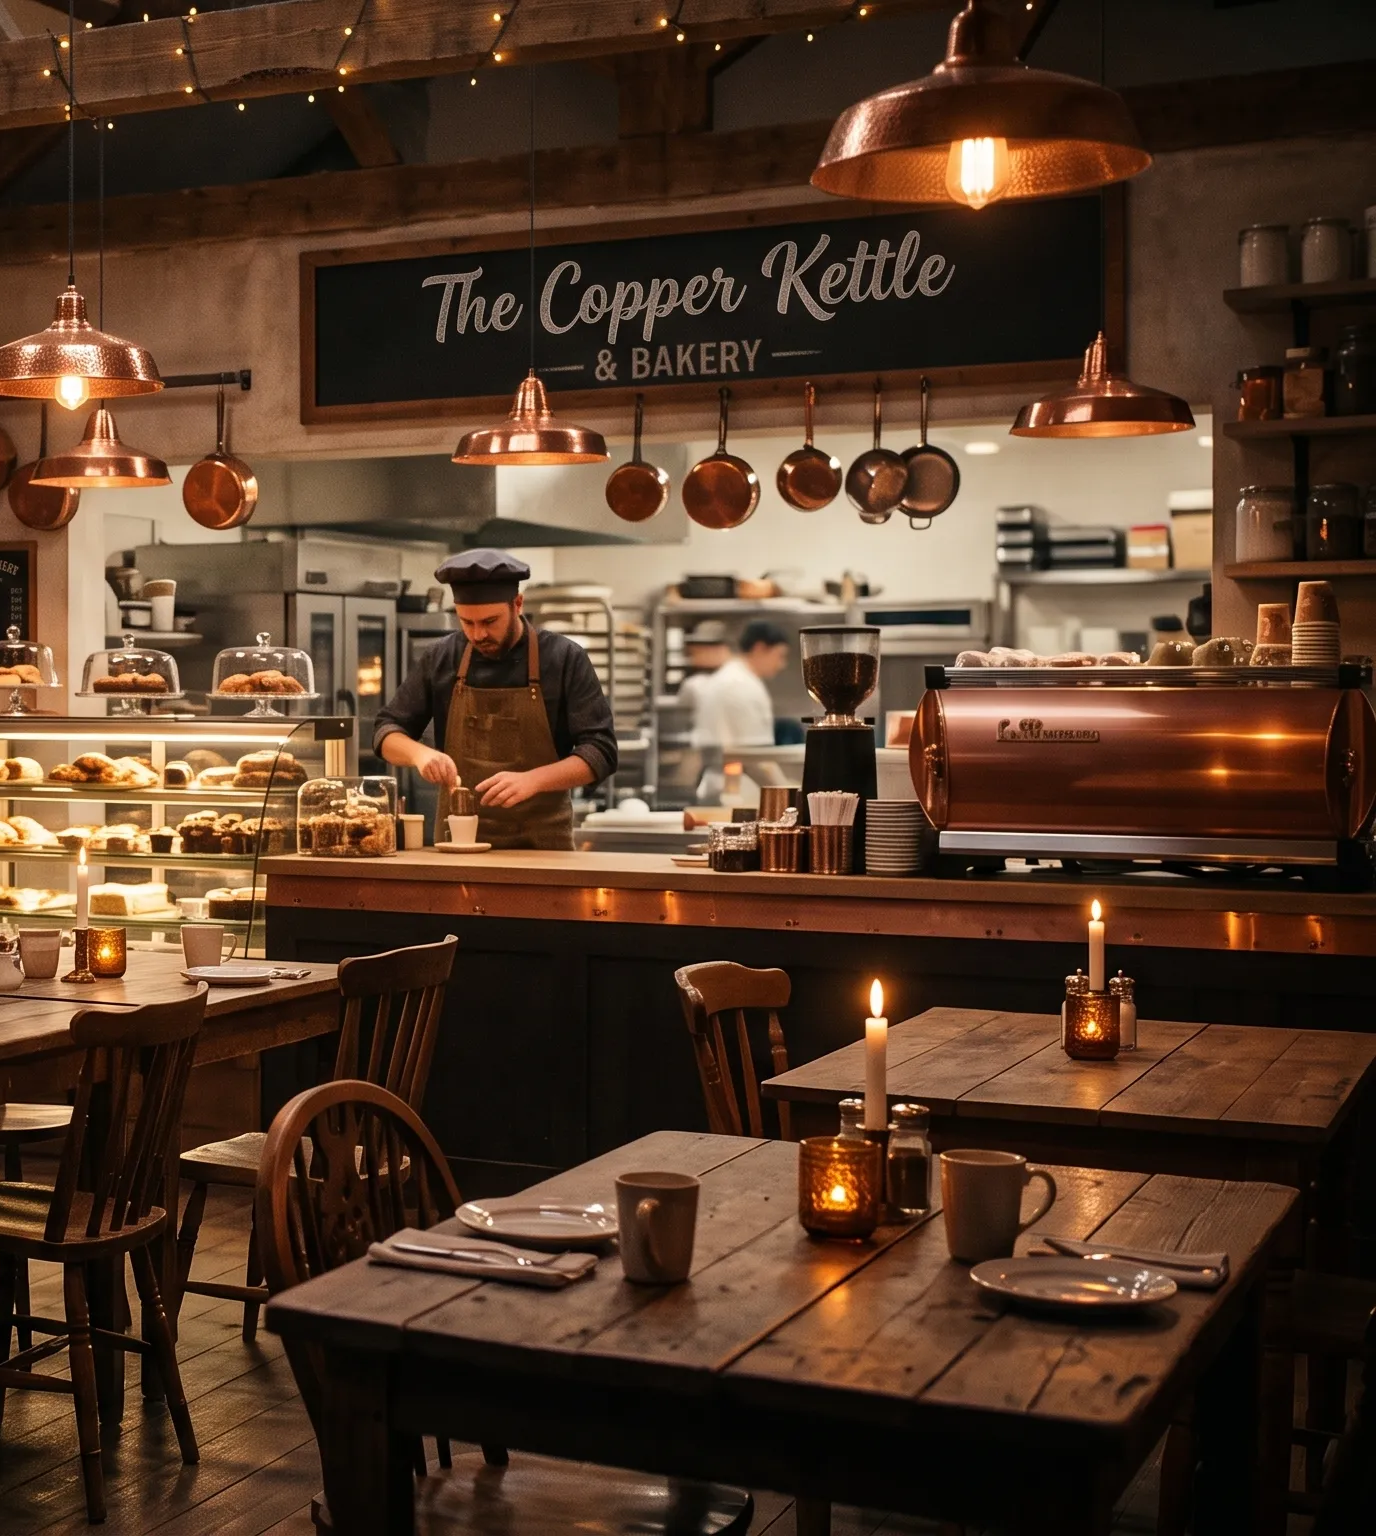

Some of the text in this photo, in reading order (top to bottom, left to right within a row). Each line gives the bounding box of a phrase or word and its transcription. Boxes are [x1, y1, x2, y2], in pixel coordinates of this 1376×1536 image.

[421, 229, 956, 345] The Copper Kettle
[594, 339, 763, 381] & BAKERY
